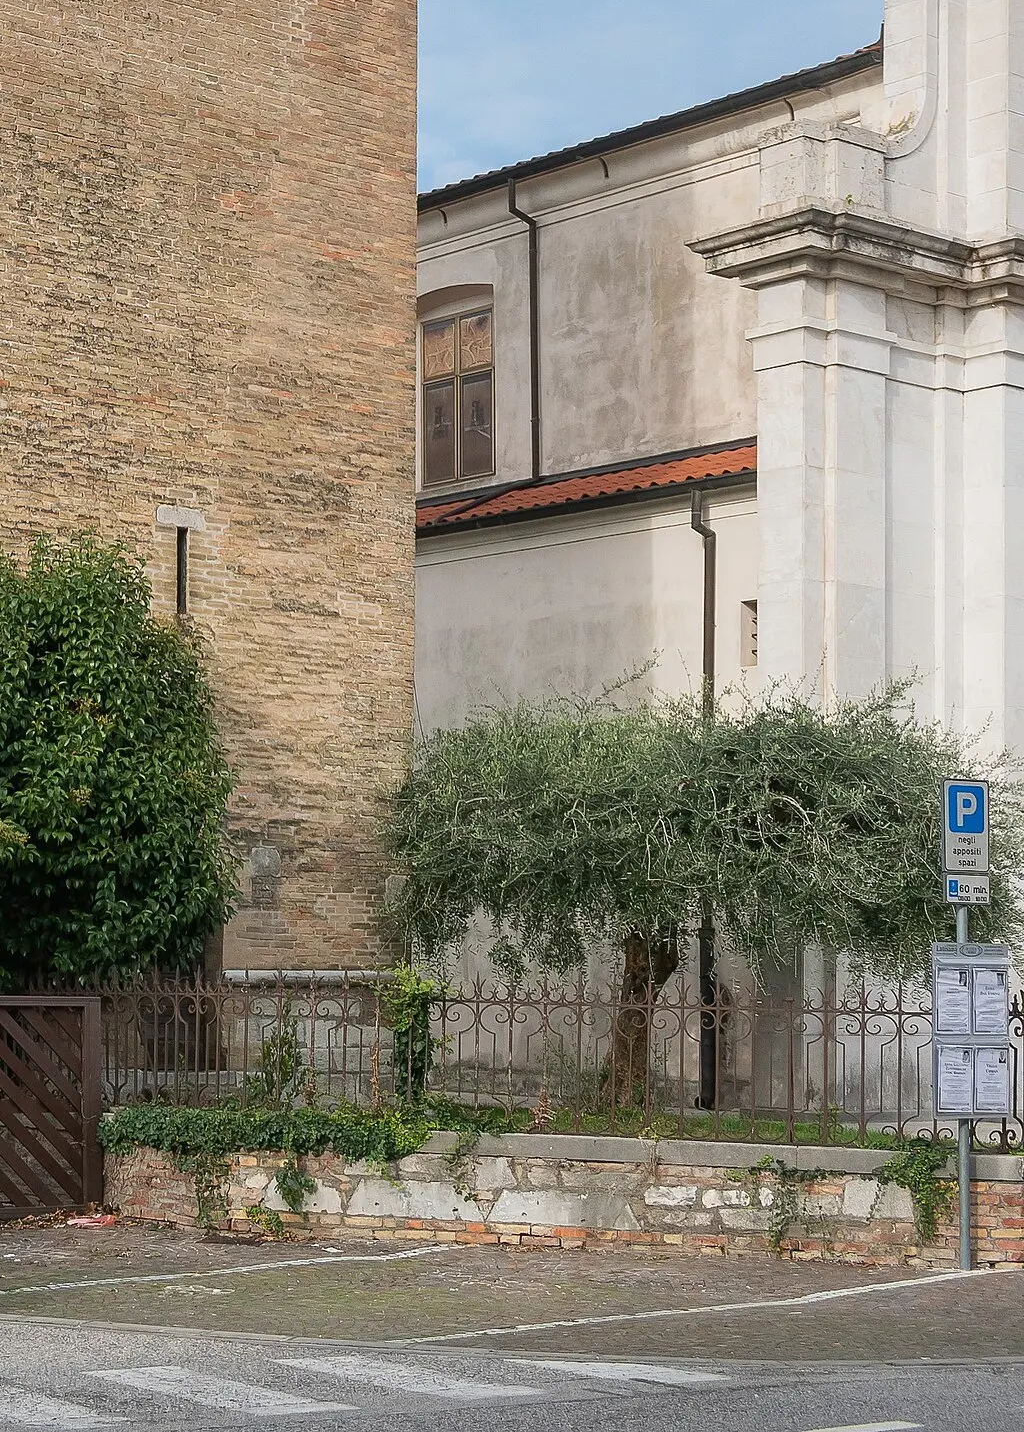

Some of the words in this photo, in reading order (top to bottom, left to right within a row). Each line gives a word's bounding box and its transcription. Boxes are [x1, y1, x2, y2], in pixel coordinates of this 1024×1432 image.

[957, 792, 978, 827] P
[958, 836, 976, 846] negli
[953, 847, 982, 856] appositi
[958, 858, 977, 867] spazi
[959, 884, 970, 893] 60
[973, 885, 988, 894] min.
